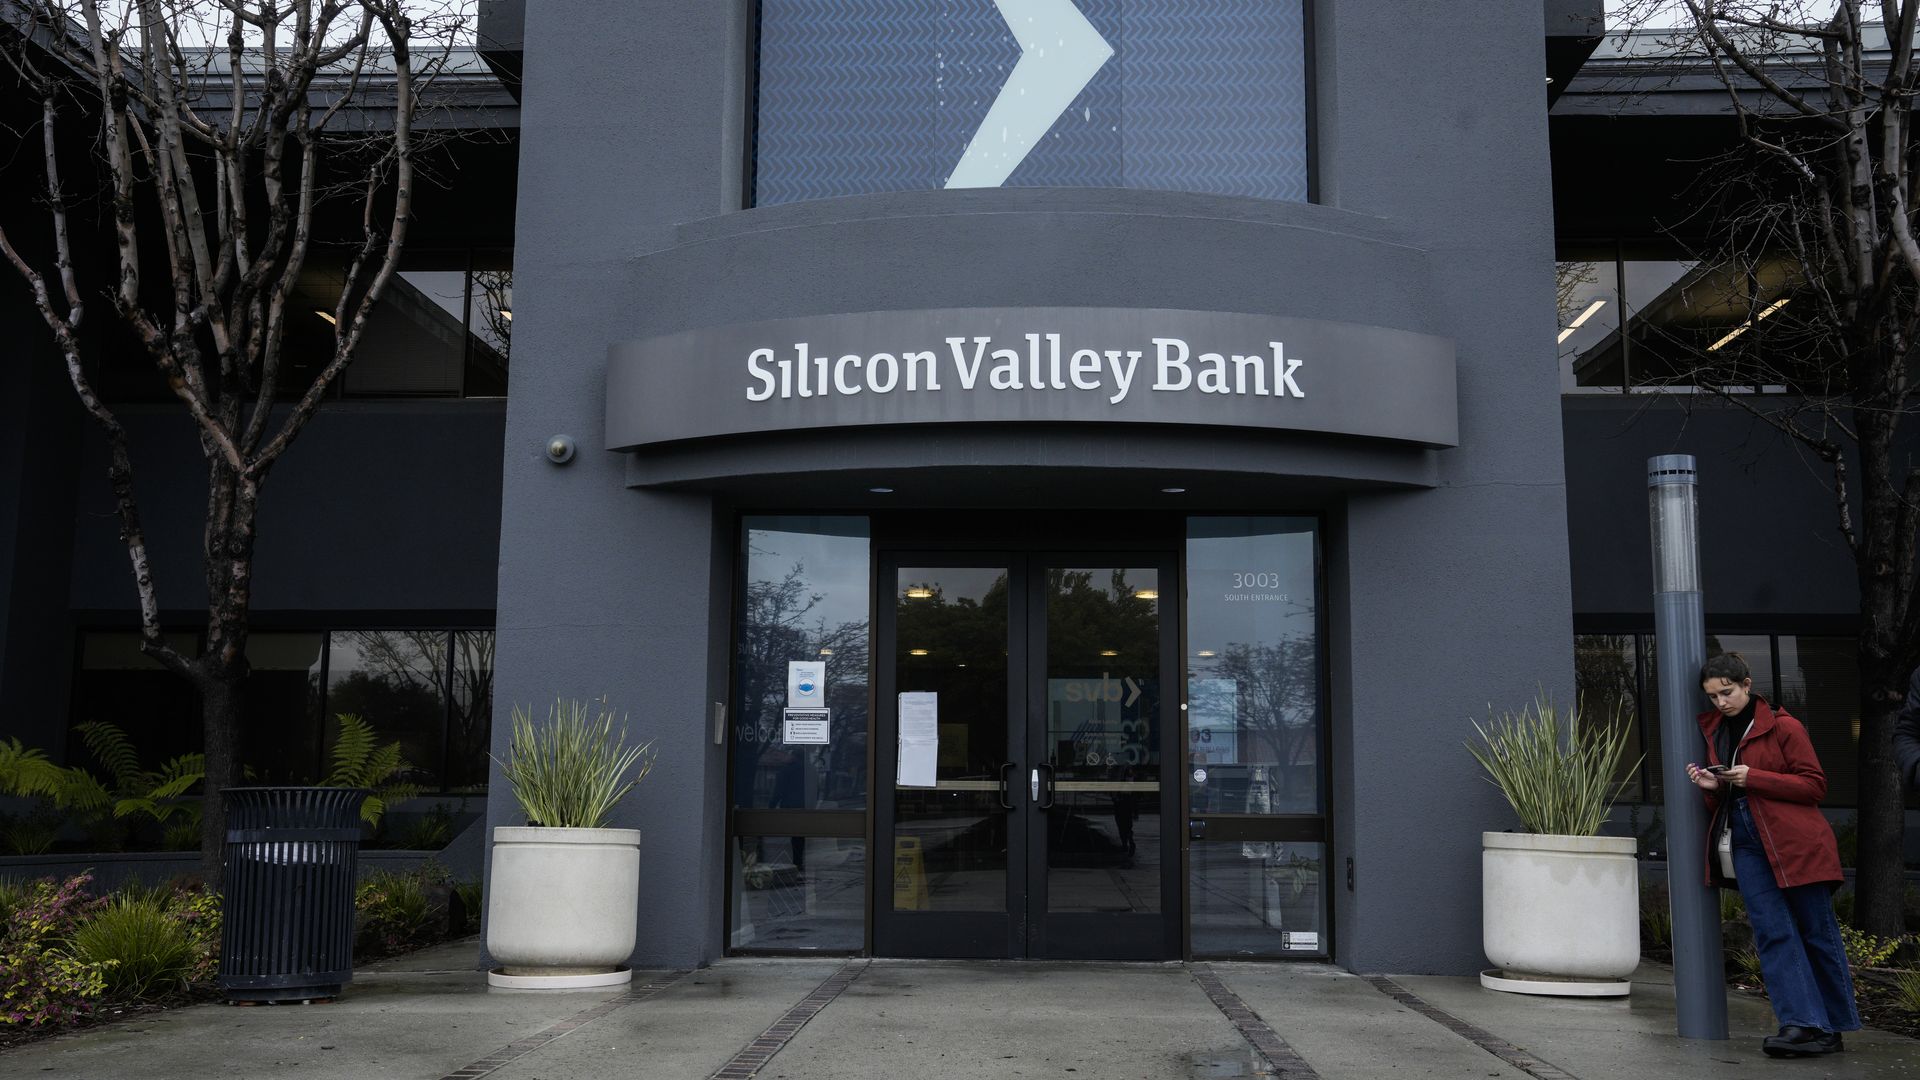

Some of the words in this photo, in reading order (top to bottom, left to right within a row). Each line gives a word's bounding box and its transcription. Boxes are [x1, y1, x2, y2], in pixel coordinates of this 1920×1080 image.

[746, 343, 941, 402] Silicon
[946, 333, 1142, 404] Valley
[1151, 337, 1305, 399] Bank
[1232, 572, 1280, 589] 3003
[1224, 593, 1249, 602] SOUTH
[1250, 593, 1288, 602] ENTRANCE
[1066, 671, 1123, 702] svb
